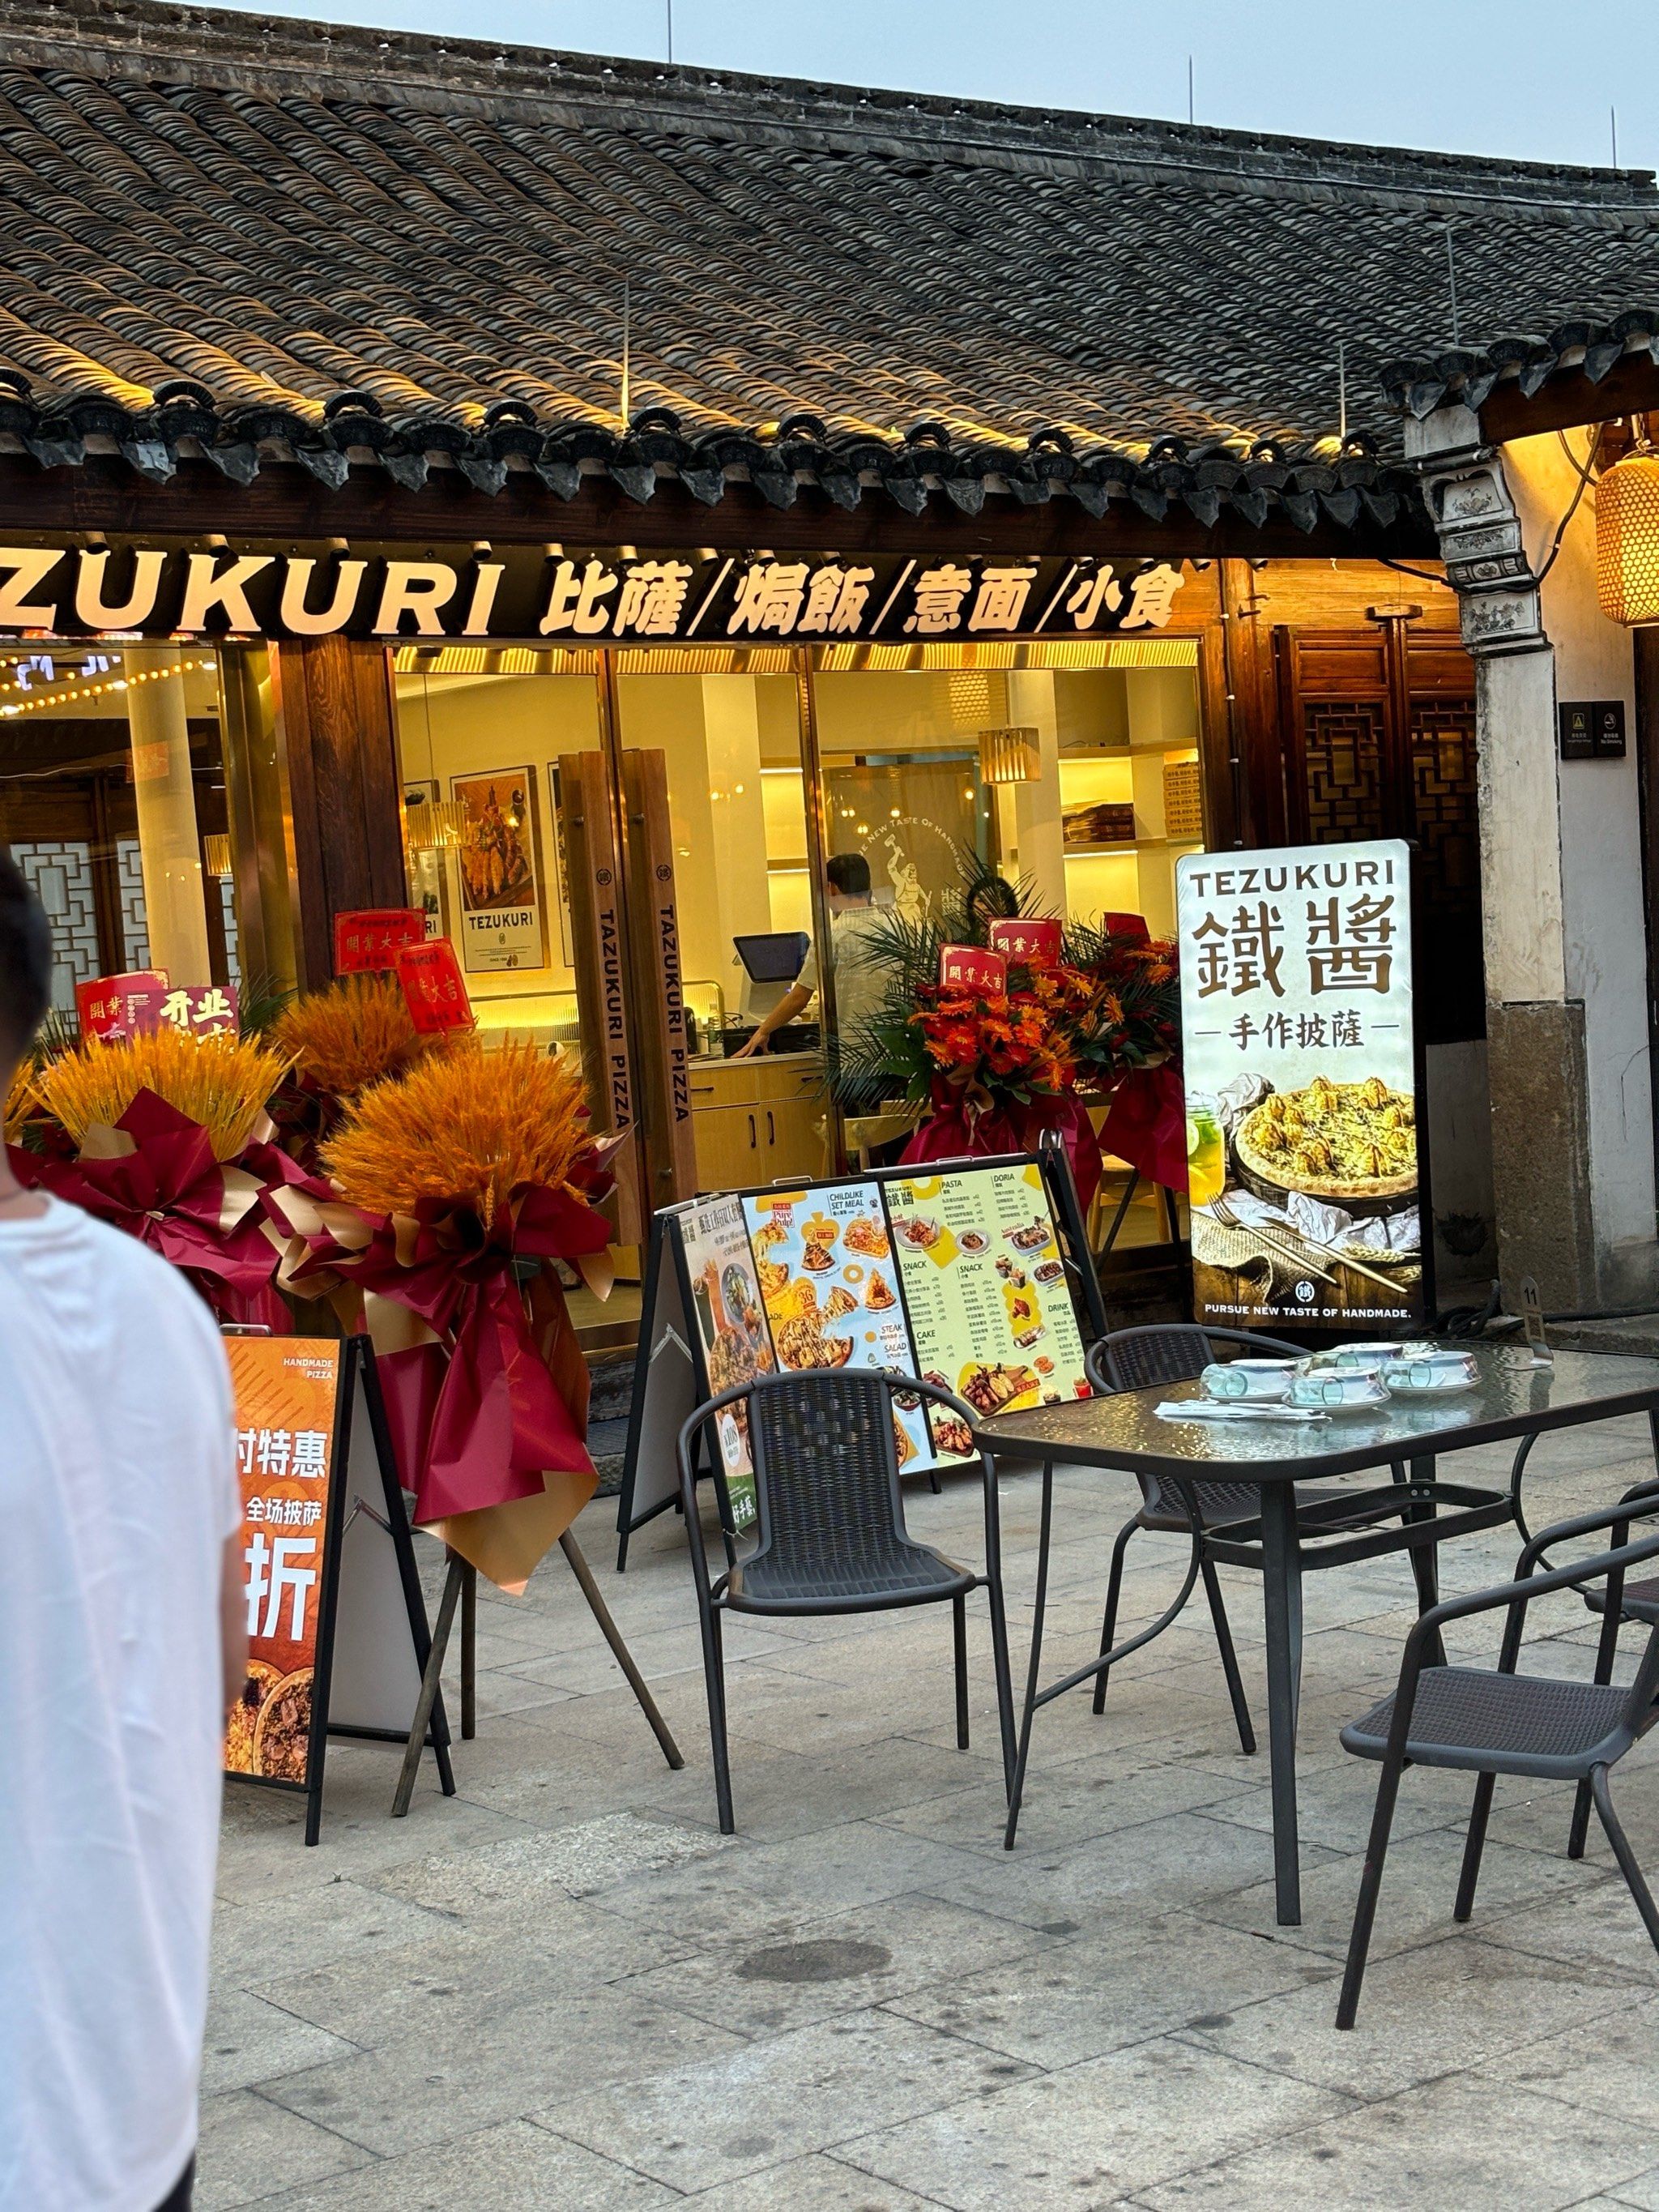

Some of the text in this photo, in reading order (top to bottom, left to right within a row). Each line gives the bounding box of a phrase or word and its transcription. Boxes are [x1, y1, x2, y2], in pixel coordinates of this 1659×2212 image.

[867, 824, 889, 843] NEW
[889, 816, 919, 827] TASTE
[921, 818, 934, 828] OF
[1189, 860, 1395, 898] TEZUKURI
[468, 911, 534, 931] TEZUKURI
[949, 965, 1003, 989] 開業大吉
[160, 988, 234, 1027] 开业
[659, 903, 689, 1123] TAZUKURI PIZZA
[599, 908, 631, 1129] TAZUKURI PIZZA
[1227, 1010, 1366, 1051] 手作披薩
[993, 1173, 1015, 1182] DORIA
[941, 1180, 963, 1189] PASTA
[830, 1190, 864, 1202] CHILDLIKE
[831, 1199, 864, 1211] SET MEAL
[903, 1261, 927, 1271] SNACK
[959, 1263, 983, 1273] SNACK
[1047, 1303, 1069, 1313] DRINK
[1205, 1304, 1412, 1319] PURSUE NEW TASTE OF HANDMADE.
[881, 1323, 903, 1334] STEAK
[916, 1330, 936, 1339] CAKE
[884, 1342, 907, 1352] SALAD
[283, 1357, 334, 1369] HANDMADE
[306, 1370, 333, 1379] PIZZA
[245, 1496, 322, 1527] 全场披萨
